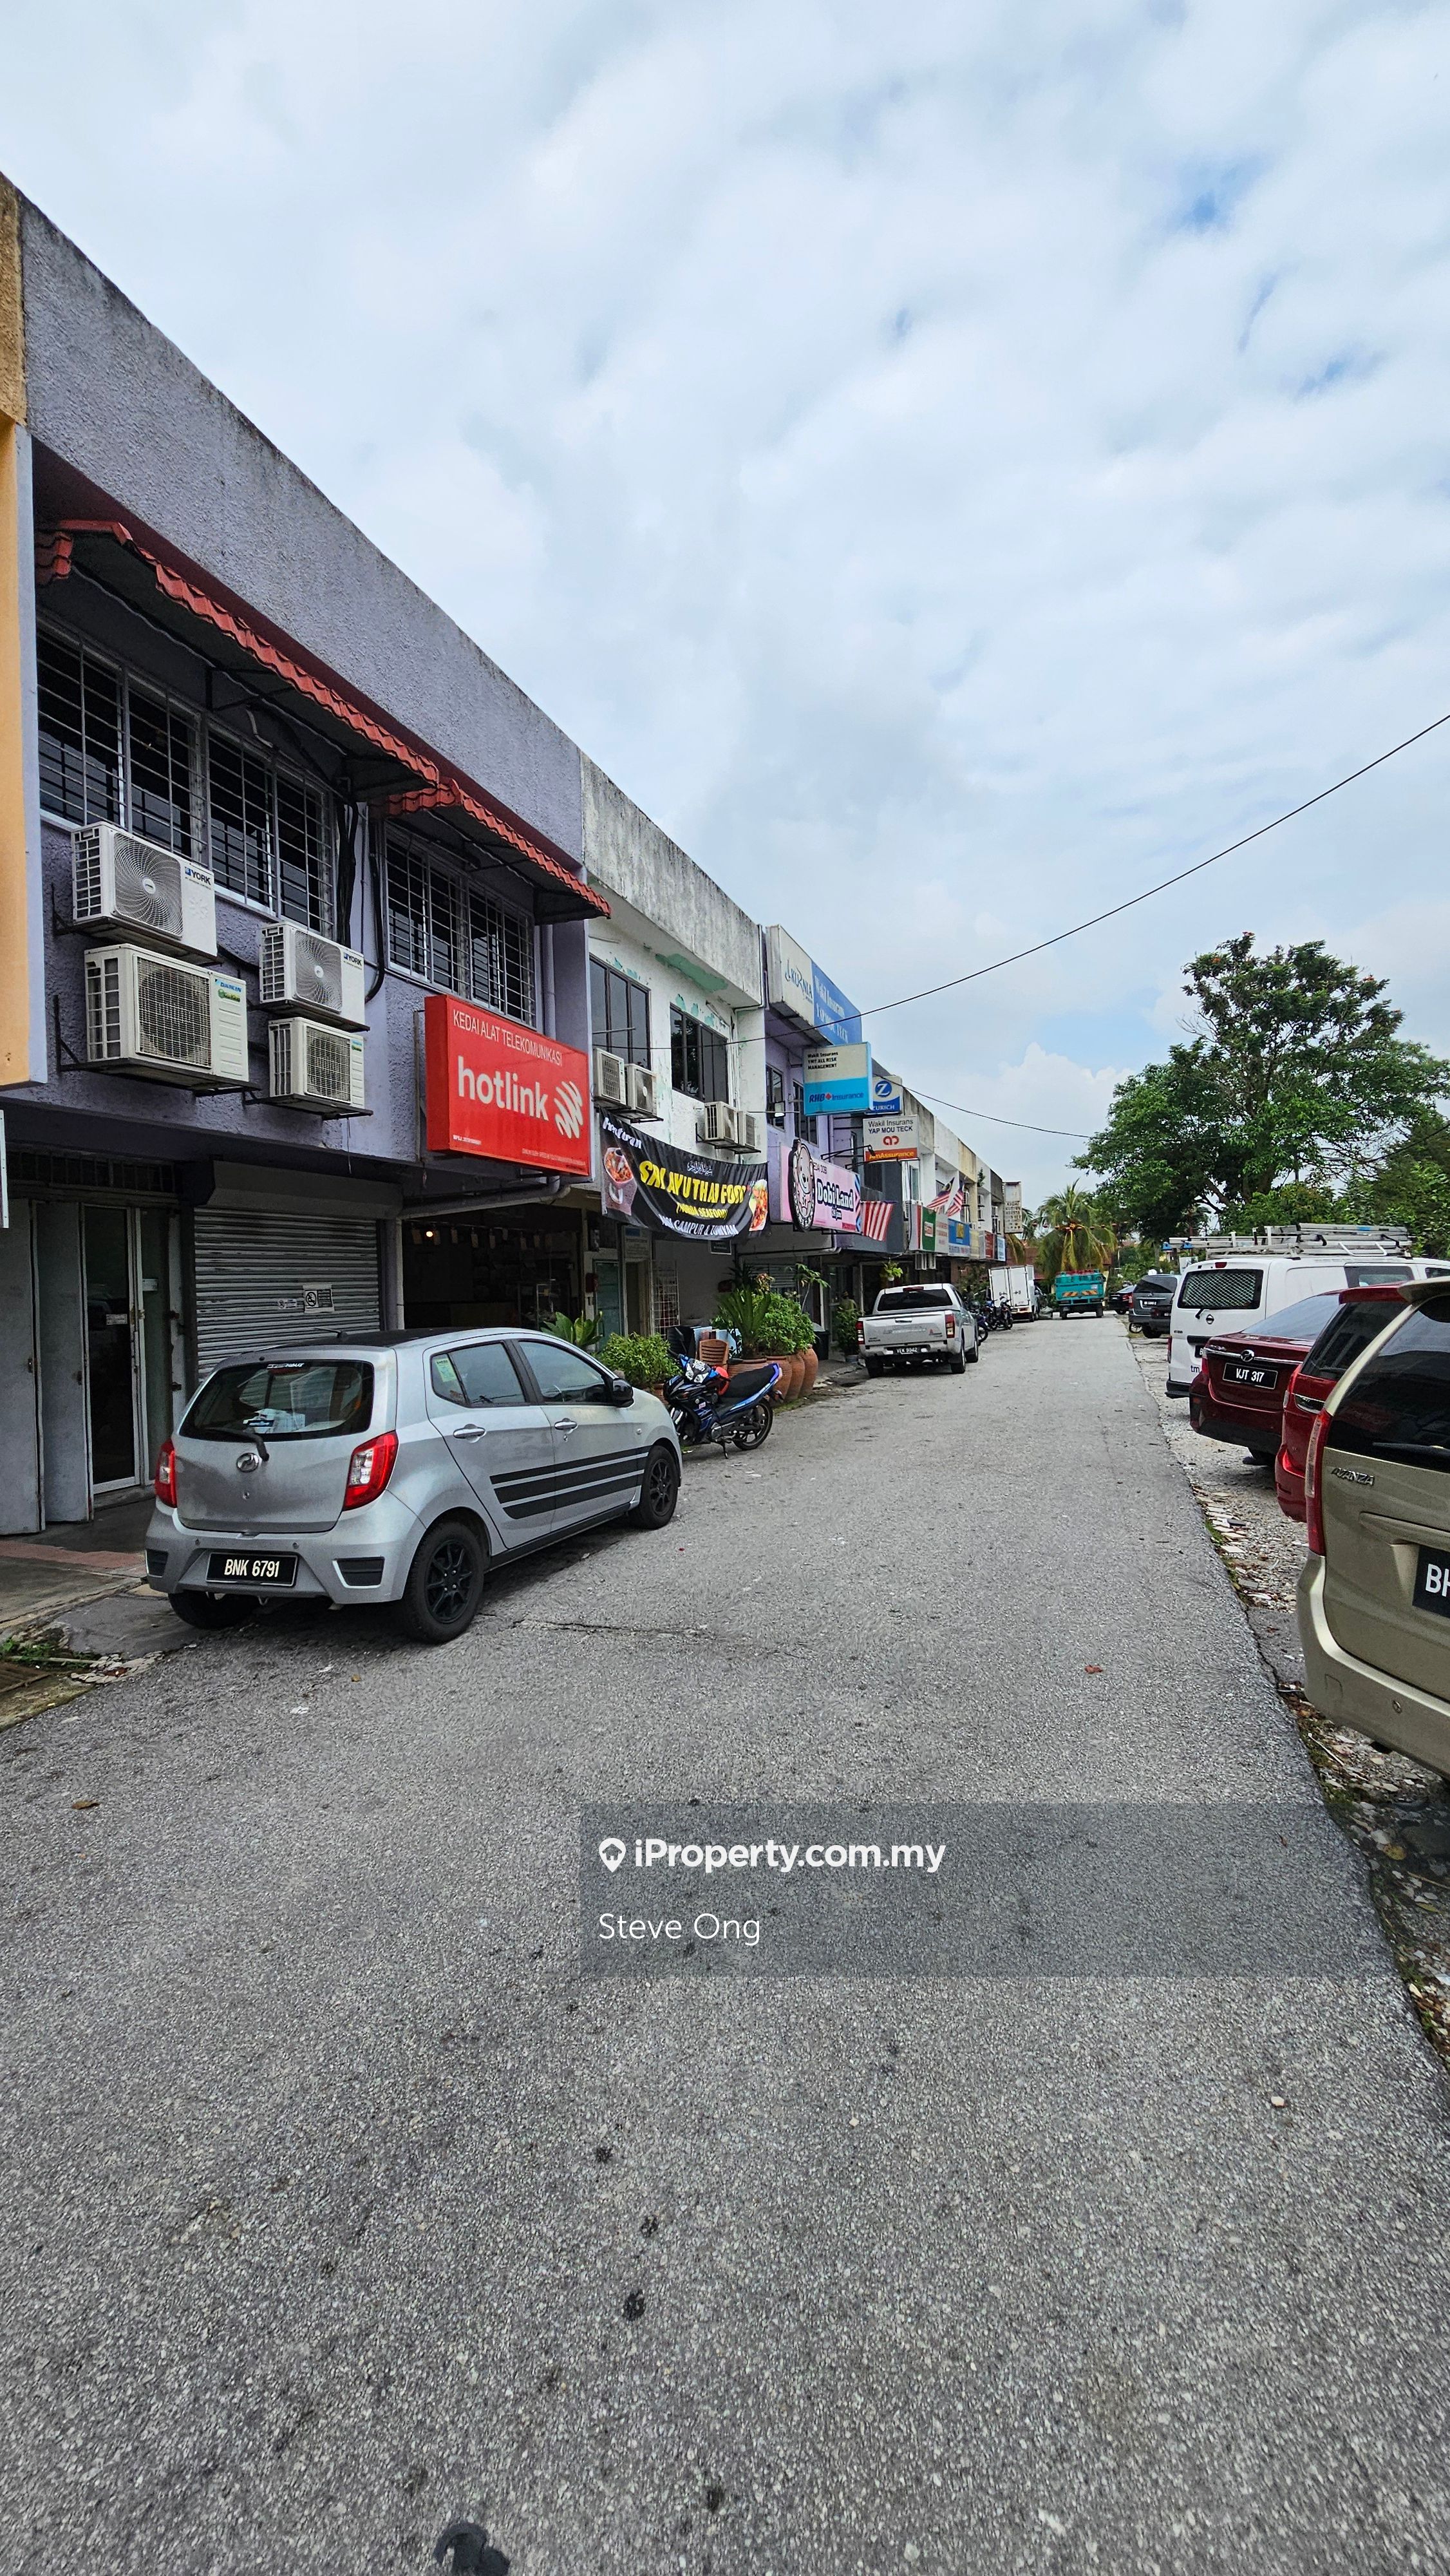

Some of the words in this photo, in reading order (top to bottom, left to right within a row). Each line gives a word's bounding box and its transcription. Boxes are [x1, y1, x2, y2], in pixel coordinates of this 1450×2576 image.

[191, 869, 211, 885] YORK
[453, 1009, 479, 1034] KEDAI
[480, 1021, 500, 1042] ALAT
[501, 1029, 562, 1066] TELEKOMUNIKASI
[458, 1055, 549, 1121] hotlink
[809, 1093, 825, 1103] RHB
[832, 1092, 864, 1101] Insurance
[869, 1151, 914, 1160] AmAssurance
[816, 1178, 835, 1206] Dobi
[835, 1184, 854, 1211] Land
[674, 1220, 705, 1235] CAMPUR
[1236, 1368, 1250, 1381] VJT
[1251, 1372, 1265, 1383] 317
[1331, 1468, 1375, 1486] AVANZA
[224, 1558, 250, 1577] BNK
[252, 1560, 280, 1578] 6791
